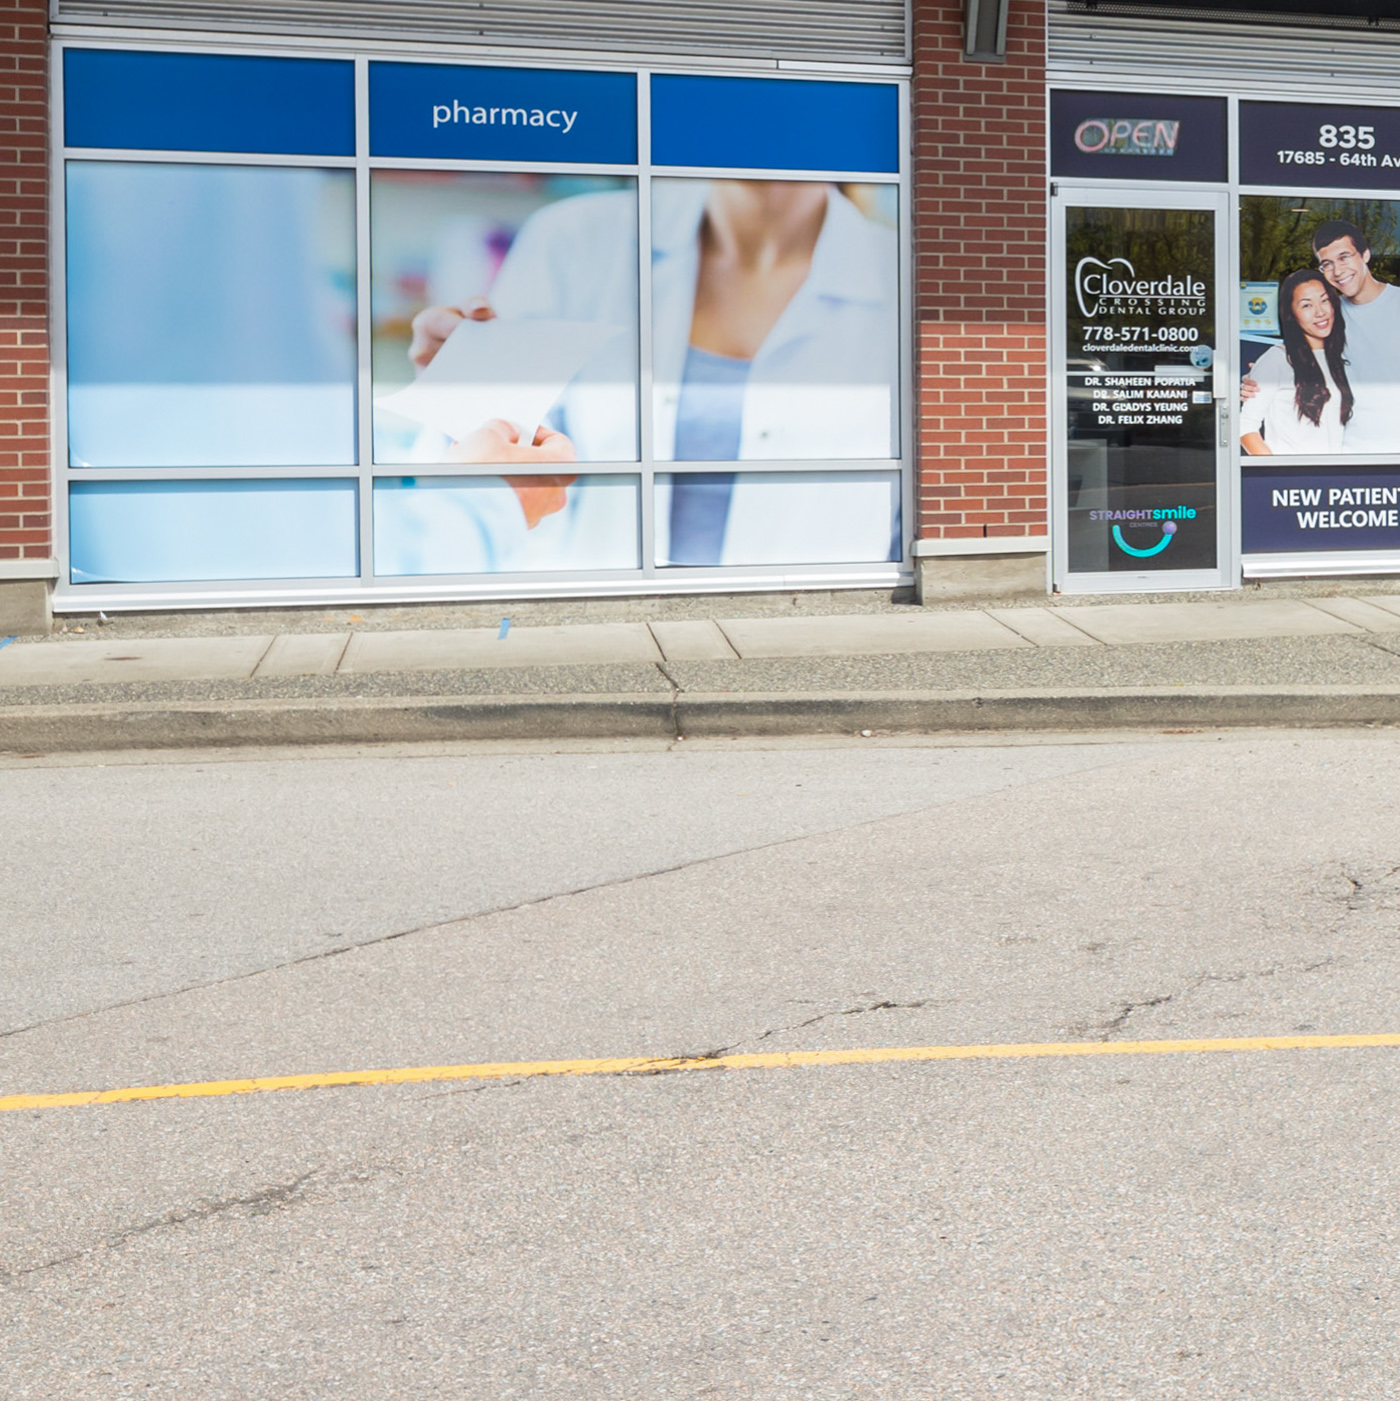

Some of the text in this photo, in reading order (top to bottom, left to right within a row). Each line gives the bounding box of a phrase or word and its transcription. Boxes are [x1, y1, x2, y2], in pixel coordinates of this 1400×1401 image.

[433, 99, 578, 134] pharmacy
[1075, 121, 1180, 152] OPEN
[1319, 124, 1376, 150] 835
[1277, 150, 1325, 166] 17685
[1340, 152, 1377, 168] 64th
[1084, 273, 1206, 296] Cloverdale
[1099, 298, 1206, 306] CROSSING
[1099, 306, 1206, 316] DENTAL GROUP
[1083, 326, 1199, 342] 778-571-0800
[1082, 344, 1198, 353] cloverdaledentalclinic.com
[1084, 377, 1102, 387] DR.
[1105, 377, 1152, 387] SHAHEEN
[1093, 390, 1110, 399] DR.
[1113, 390, 1144, 399] SALIM
[1147, 390, 1188, 399] KAMANI
[1092, 402, 1188, 412] DR. GLADYS YEUNG
[1098, 415, 1183, 425] DR. FELIX ZHANG
[1272, 488, 1322, 507] NEW
[1297, 510, 1399, 529] WELCOME
